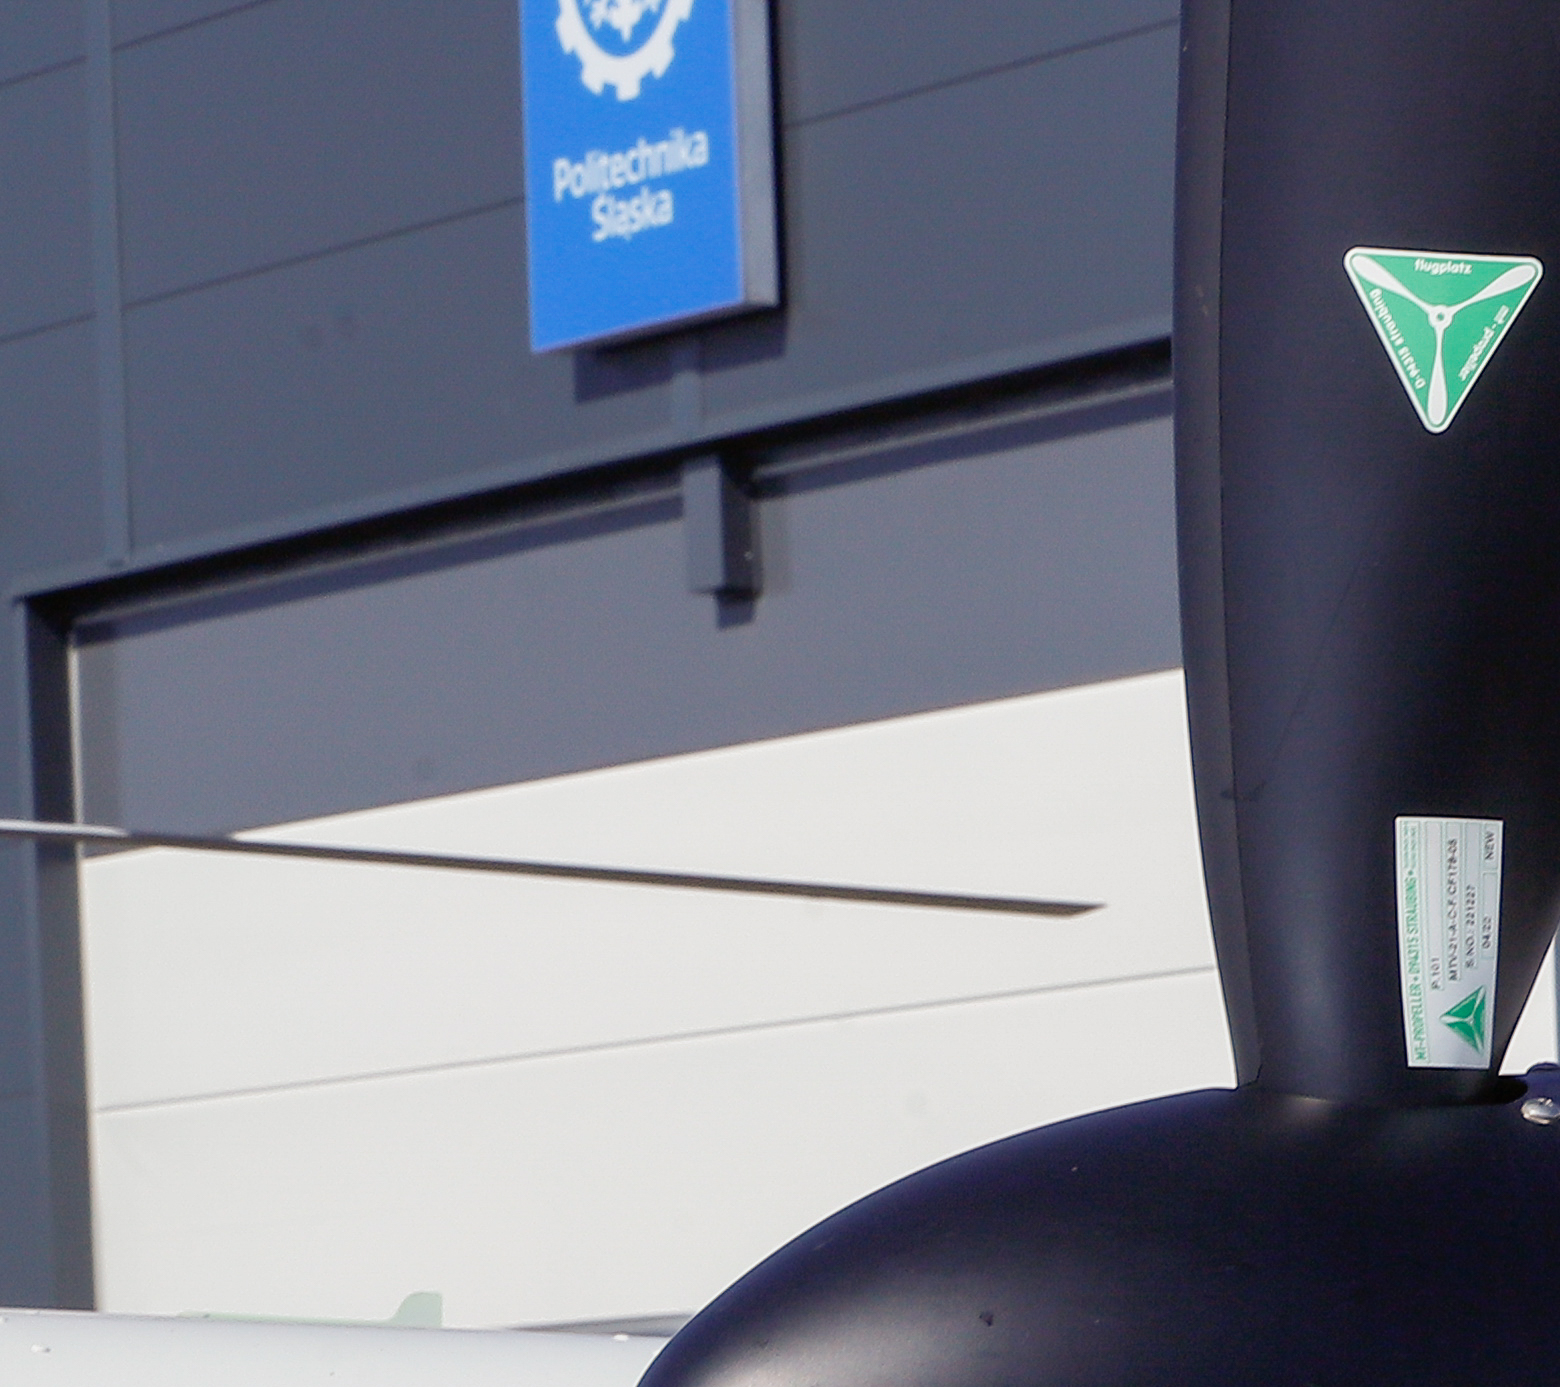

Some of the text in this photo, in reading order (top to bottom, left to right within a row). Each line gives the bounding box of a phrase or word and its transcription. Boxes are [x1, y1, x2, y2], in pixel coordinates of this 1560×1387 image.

[552, 127, 709, 203] Politechnika
[1414, 258, 1473, 276] flugplatz
[1484, 830, 1496, 860] NEW
